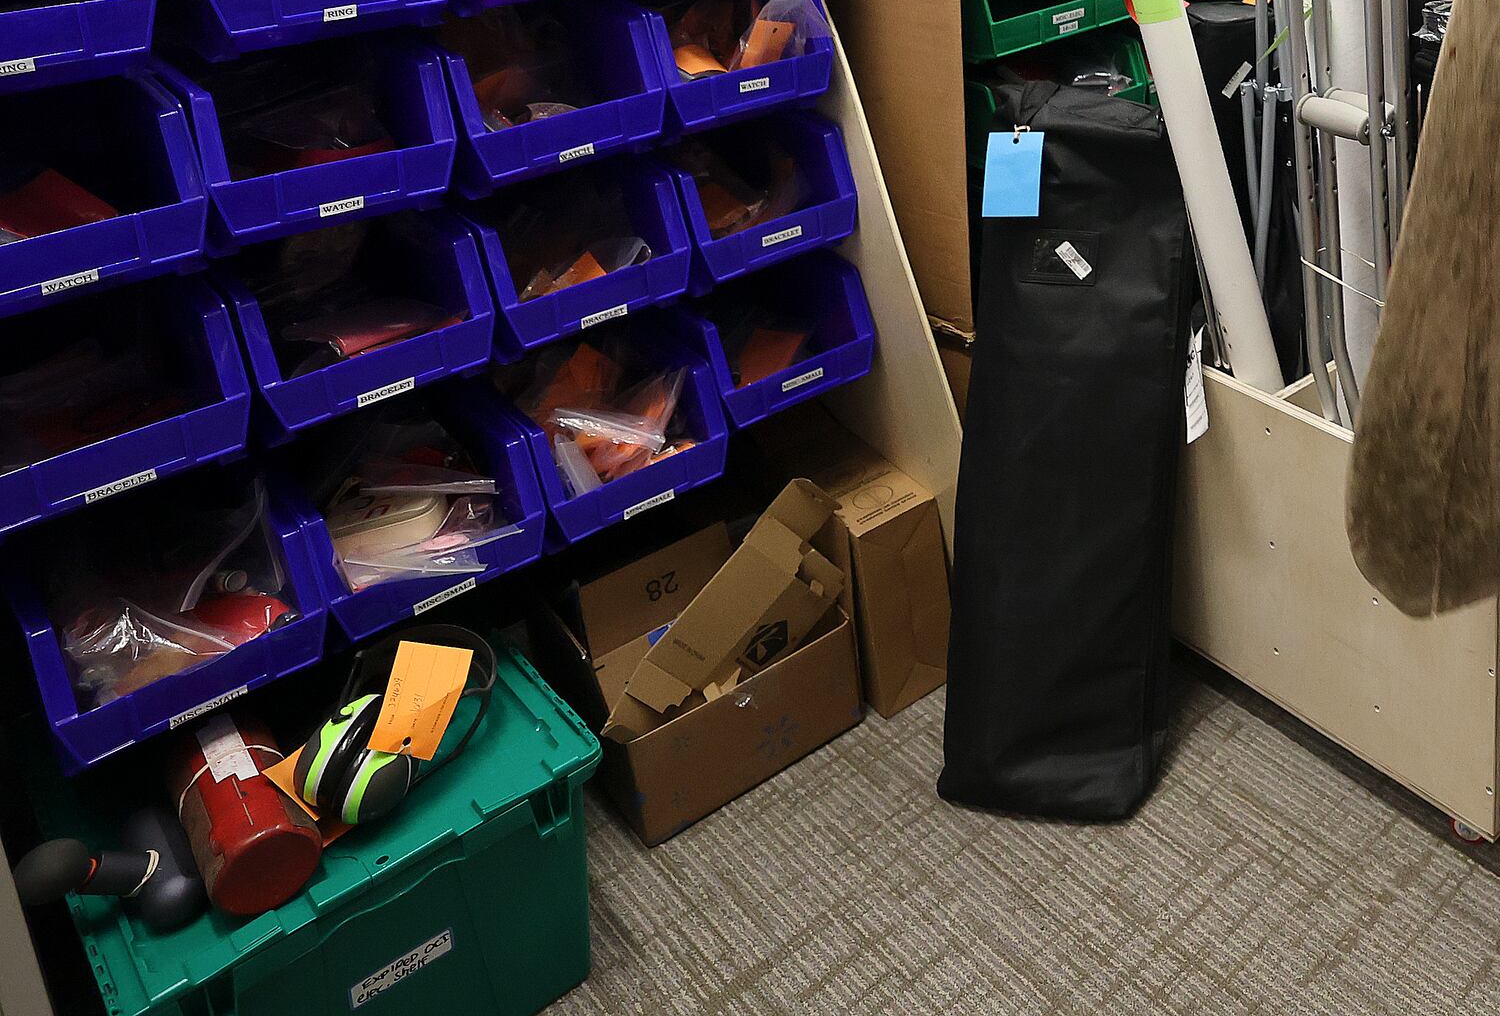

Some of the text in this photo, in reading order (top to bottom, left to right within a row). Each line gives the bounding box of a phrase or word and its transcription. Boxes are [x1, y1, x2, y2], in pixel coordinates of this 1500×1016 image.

[327, 7, 354, 19] RING
[741, 80, 768, 91] WATCH
[561, 146, 592, 162] WATCH
[322, 197, 362, 214] WATCH
[763, 228, 801, 245] BRACELET
[44, 272, 94, 295] WATCH
[582, 307, 626, 328] BRACELET
[359, 379, 413, 406] BRACELET
[87, 471, 155, 502] BRACELET
[444, 580, 475, 599] SMALL
[646, 571, 679, 602] 28
[206, 689, 240, 712] SMALL
[424, 932, 450, 955] OCT
